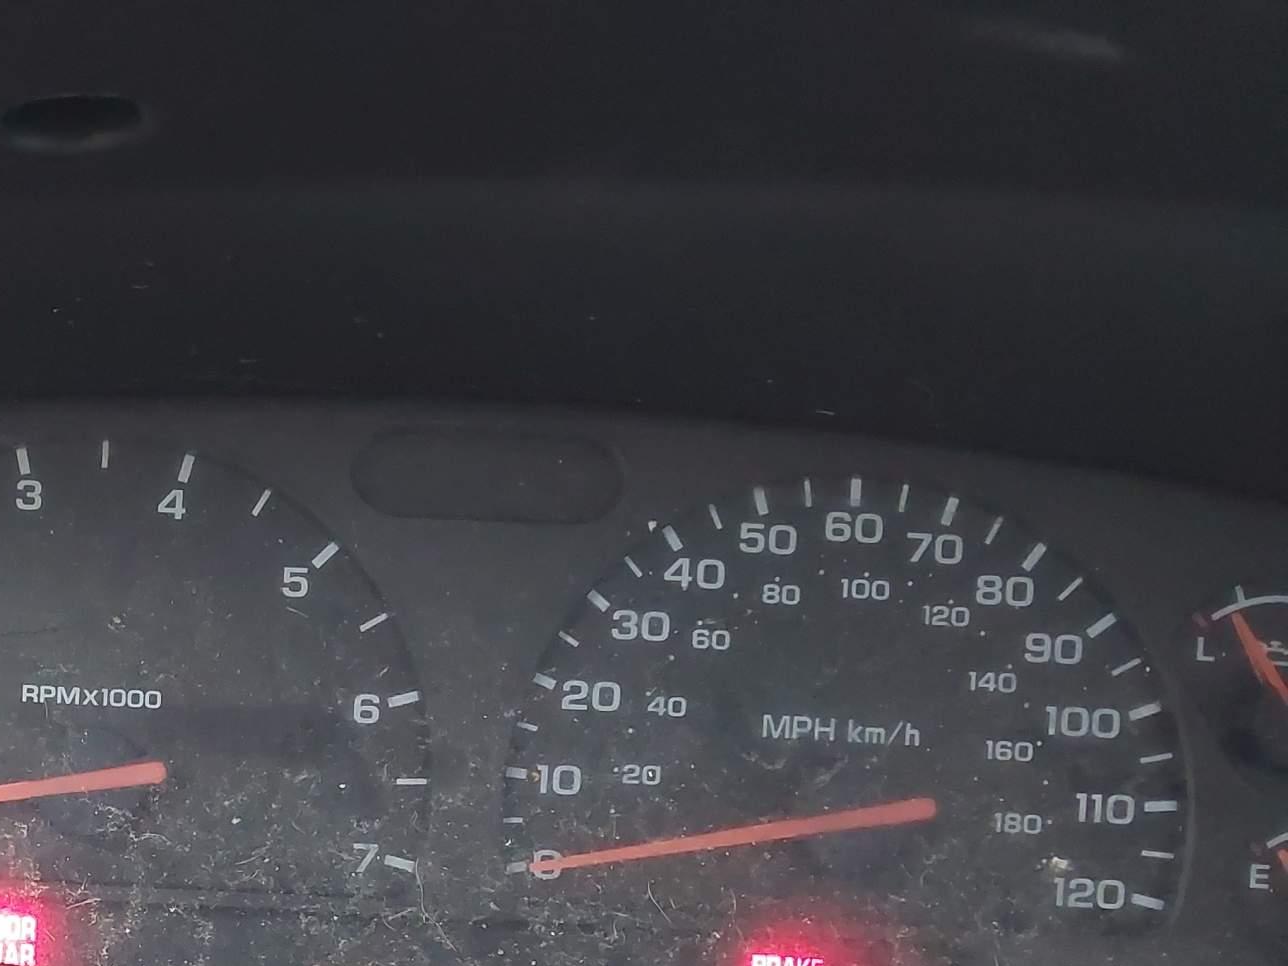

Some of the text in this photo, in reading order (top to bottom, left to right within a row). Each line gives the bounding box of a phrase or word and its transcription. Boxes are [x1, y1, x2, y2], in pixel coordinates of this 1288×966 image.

[15, 480, 43, 511] 3
[157, 489, 186, 519] 4
[739, 523, 798, 555] 50
[825, 512, 884, 544] 60
[907, 532, 963, 565] 70
[281, 567, 309, 598] 5
[664, 558, 726, 590] 40
[841, 578, 890, 600] 100
[762, 584, 801, 605] 80
[976, 575, 1034, 607] 80
[611, 610, 670, 642] 30
[923, 605, 970, 627] 120
[692, 630, 731, 651] 60
[1024, 633, 1083, 665] 90
[1196, 637, 1215, 662] L
[561, 680, 621, 712] 20
[968, 671, 1017, 694] 140
[353, 693, 381, 724] 6
[647, 696, 687, 718] 40
[1045, 706, 1121, 739] 100
[762, 714, 921, 747] MPH km/h
[985, 740, 1034, 762] 160
[538, 764, 582, 795] 10
[622, 764, 661, 785] 20
[994, 813, 1042, 834] 180
[1076, 793, 1135, 825] 110
[353, 844, 380, 873] 7
[1249, 864, 1270, 889] E
[1054, 877, 1125, 910] 120
